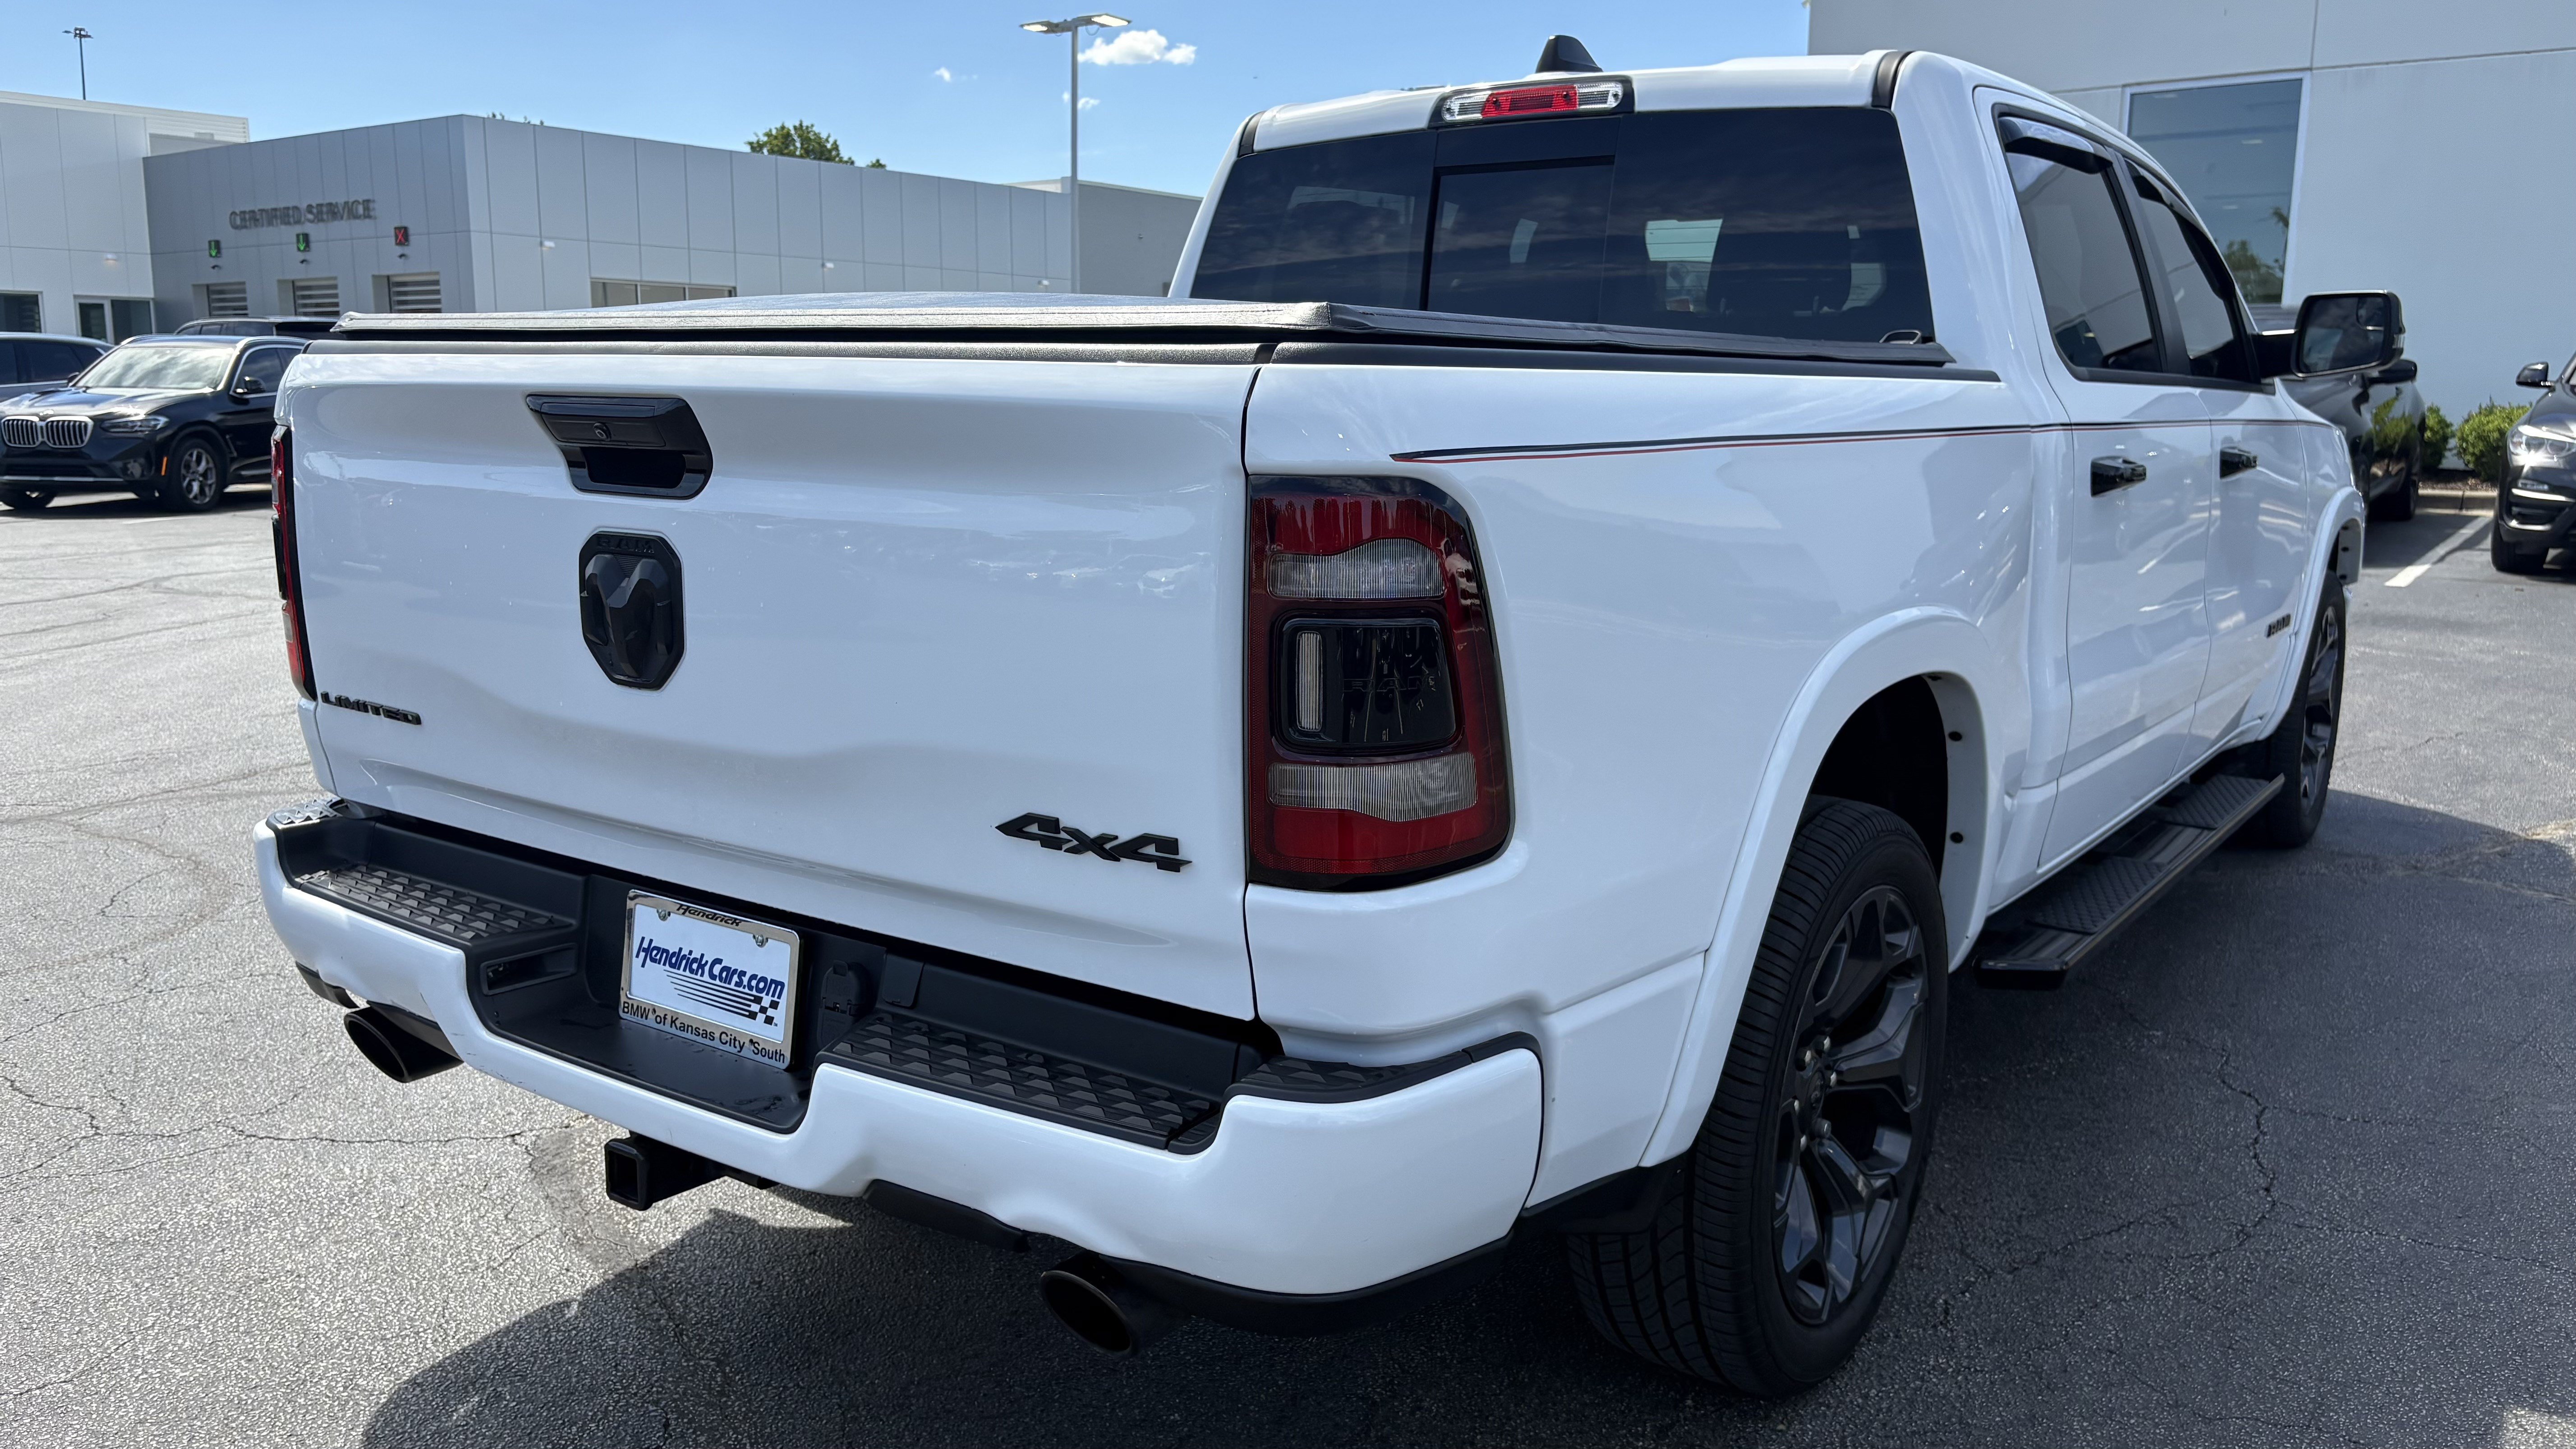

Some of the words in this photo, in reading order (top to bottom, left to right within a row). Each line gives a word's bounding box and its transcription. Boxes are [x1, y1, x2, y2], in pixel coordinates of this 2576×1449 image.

[304, 199, 376, 224] SERVICE
[321, 691, 422, 725] LIMITED
[676, 904, 742, 927] Hendrick
[622, 1001, 650, 1020] BMW
[655, 1015, 668, 1026] of
[670, 1016, 715, 1042] Kansas
[719, 1031, 745, 1053] City
[752, 1041, 786, 1064] South
